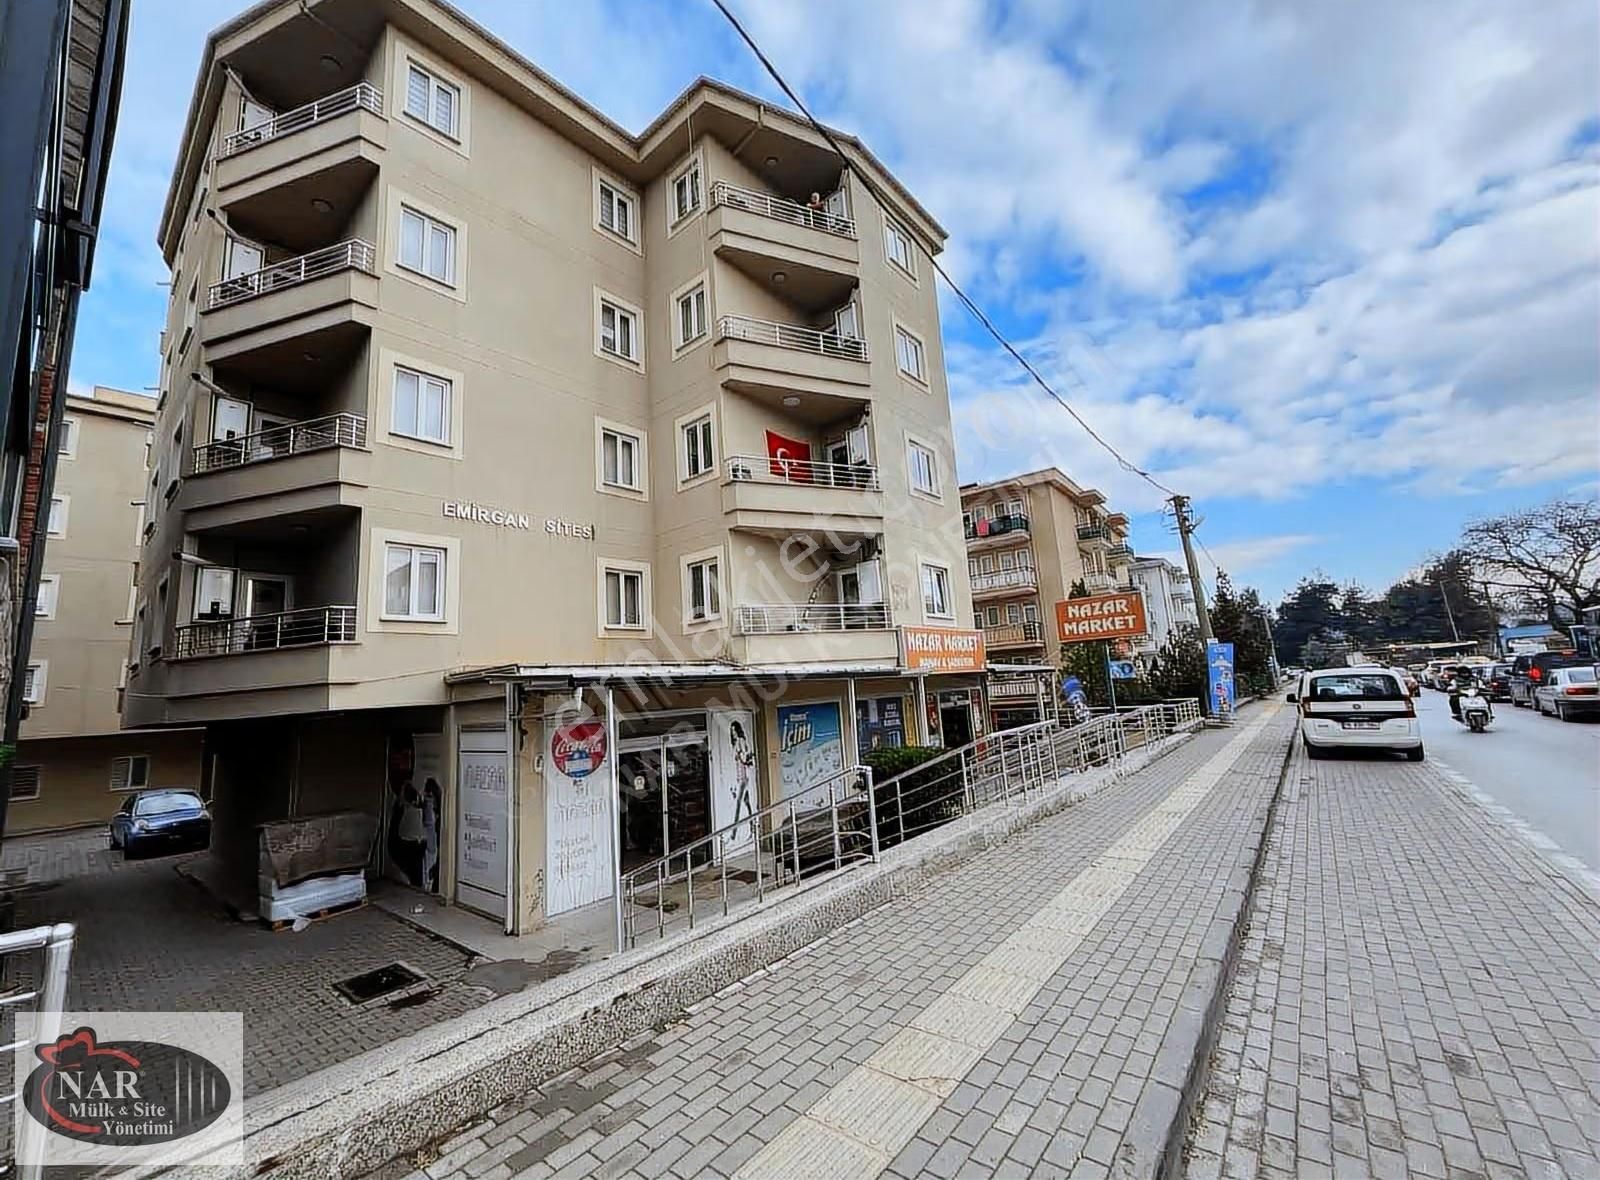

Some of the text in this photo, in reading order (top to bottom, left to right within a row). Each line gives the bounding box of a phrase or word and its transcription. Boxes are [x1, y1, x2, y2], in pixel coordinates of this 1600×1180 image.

[442, 501, 529, 529] EMİRGAN
[1067, 599, 1129, 619] NAZAR
[1063, 614, 1137, 636] MARKET
